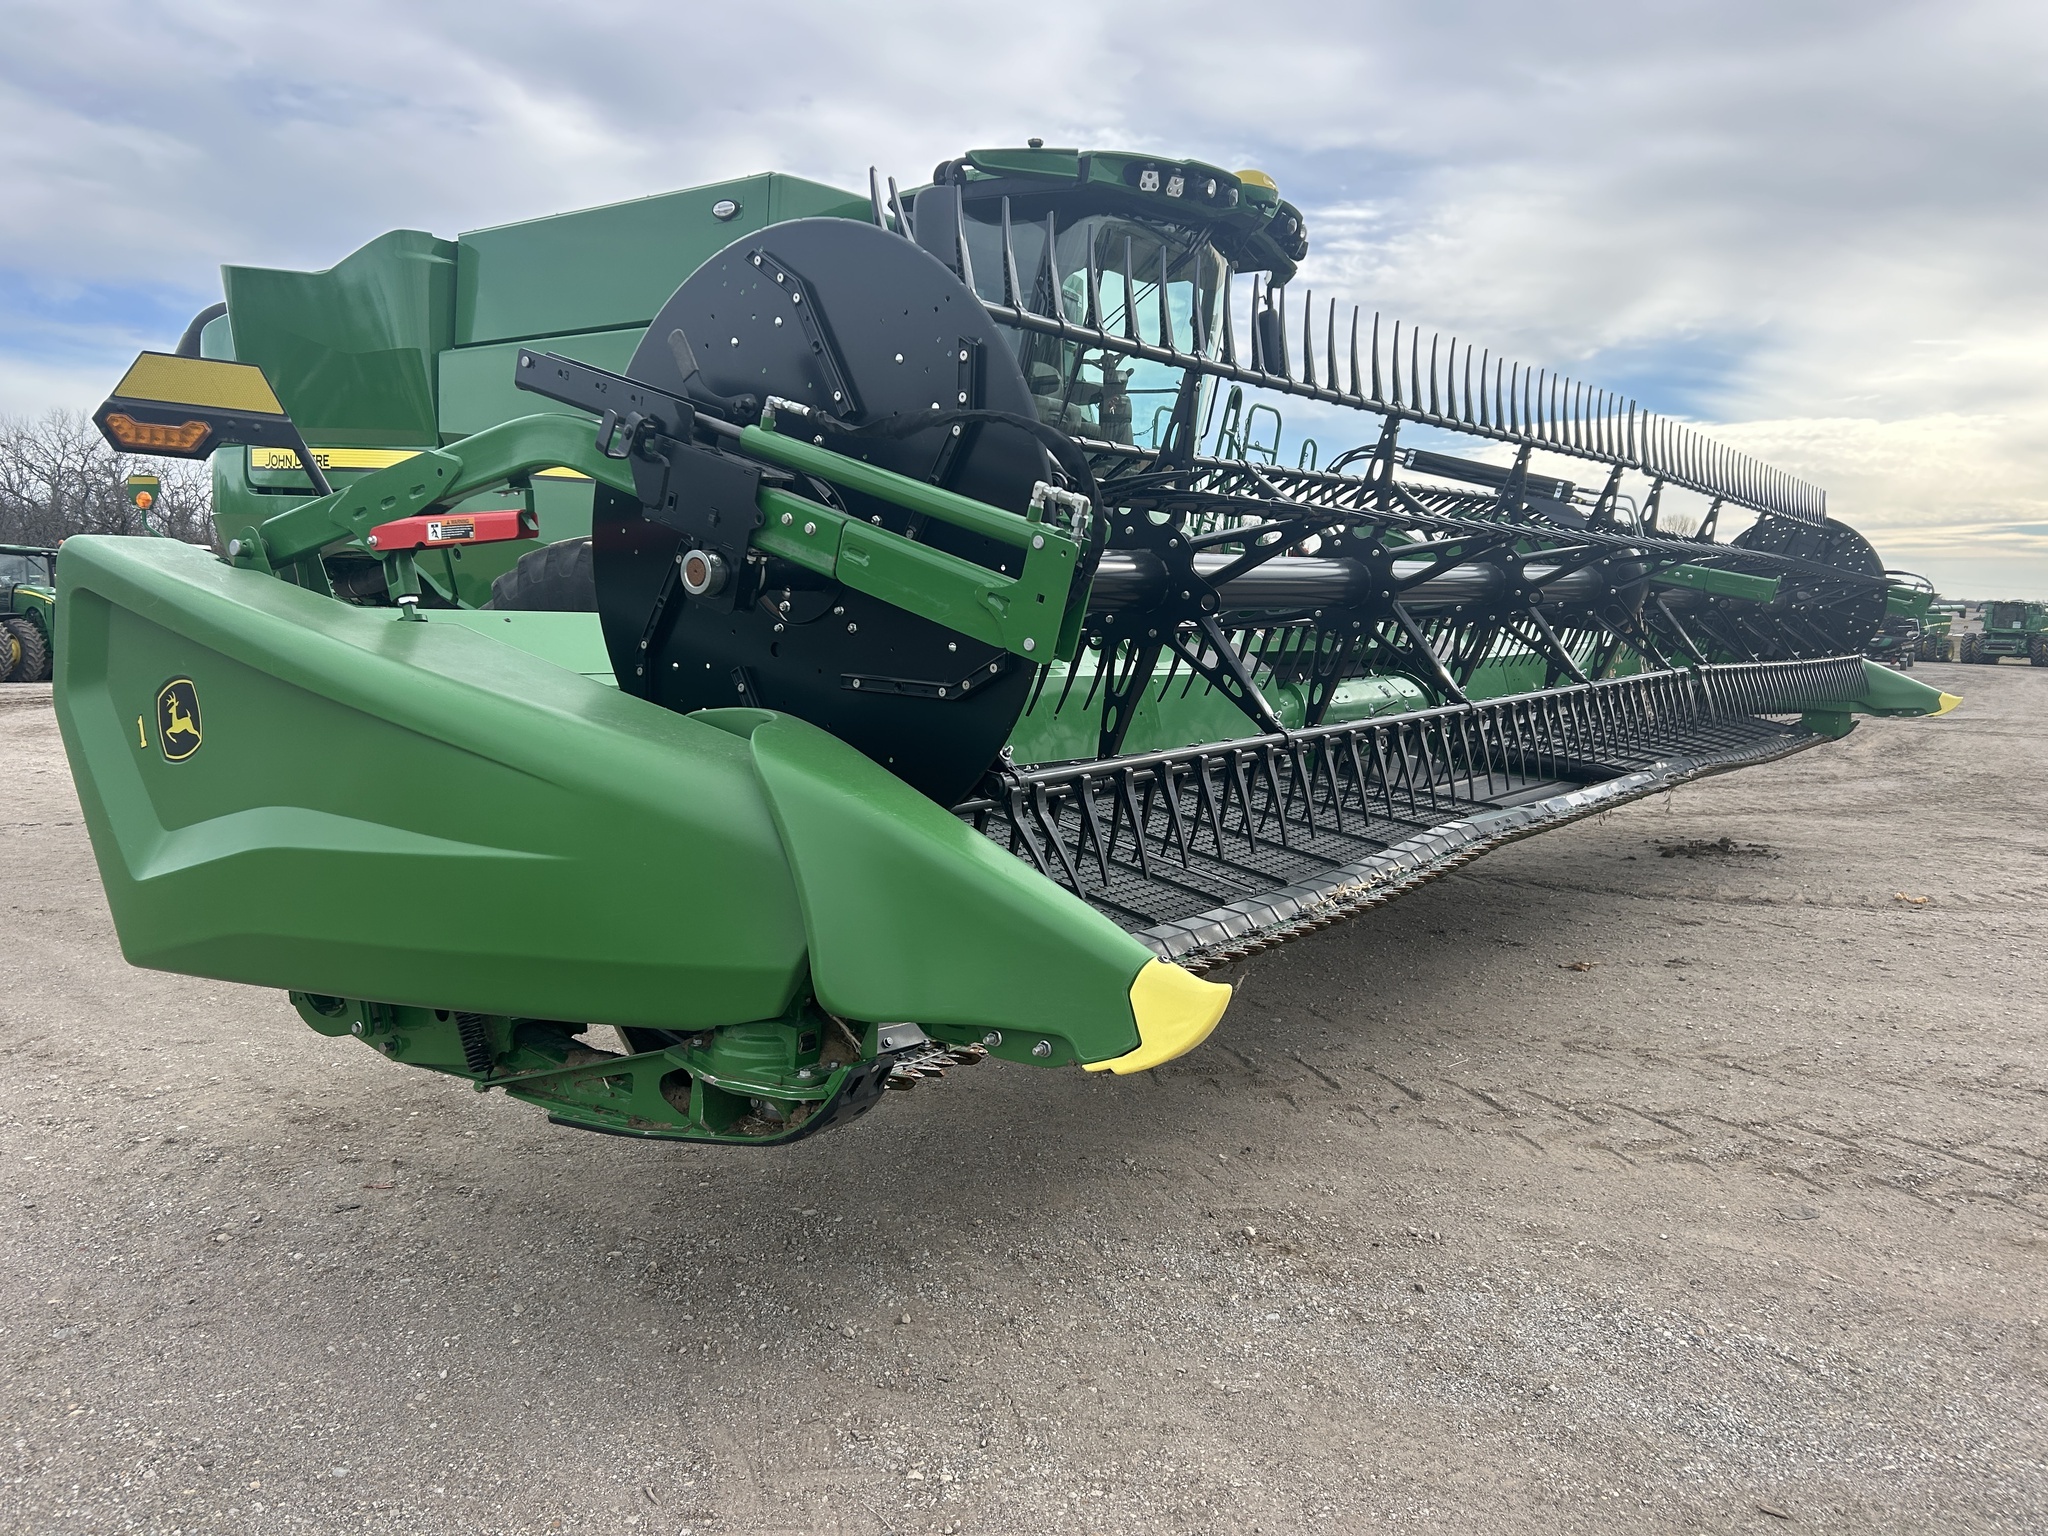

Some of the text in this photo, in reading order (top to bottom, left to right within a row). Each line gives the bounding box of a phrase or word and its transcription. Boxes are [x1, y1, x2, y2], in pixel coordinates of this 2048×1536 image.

[563, 370, 570, 381] 3
[600, 383, 608, 394] 2
[265, 452, 330, 467] JOHN DRE
[137, 714, 148, 749] 1
